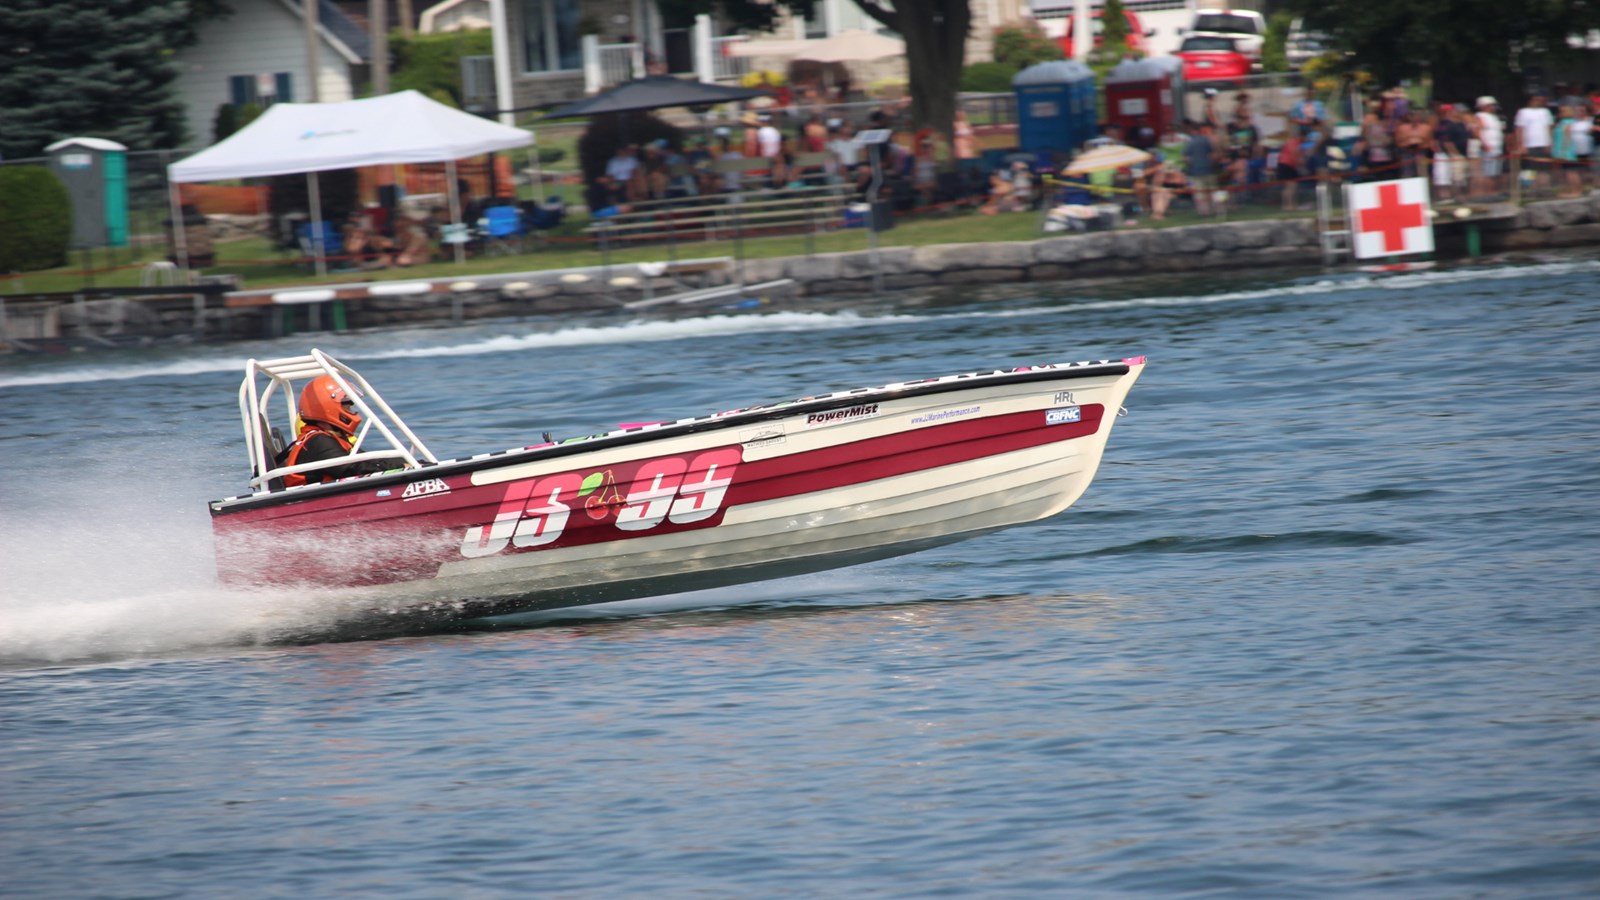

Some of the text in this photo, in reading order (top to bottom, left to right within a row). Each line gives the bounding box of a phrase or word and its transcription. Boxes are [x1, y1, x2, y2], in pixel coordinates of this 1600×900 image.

[1054, 391, 1076, 405] HRL
[807, 403, 879, 424] PowerMist
[1046, 409, 1080, 422] CBFNC
[401, 478, 451, 498] APBA
[460, 448, 742, 558] JS 99
